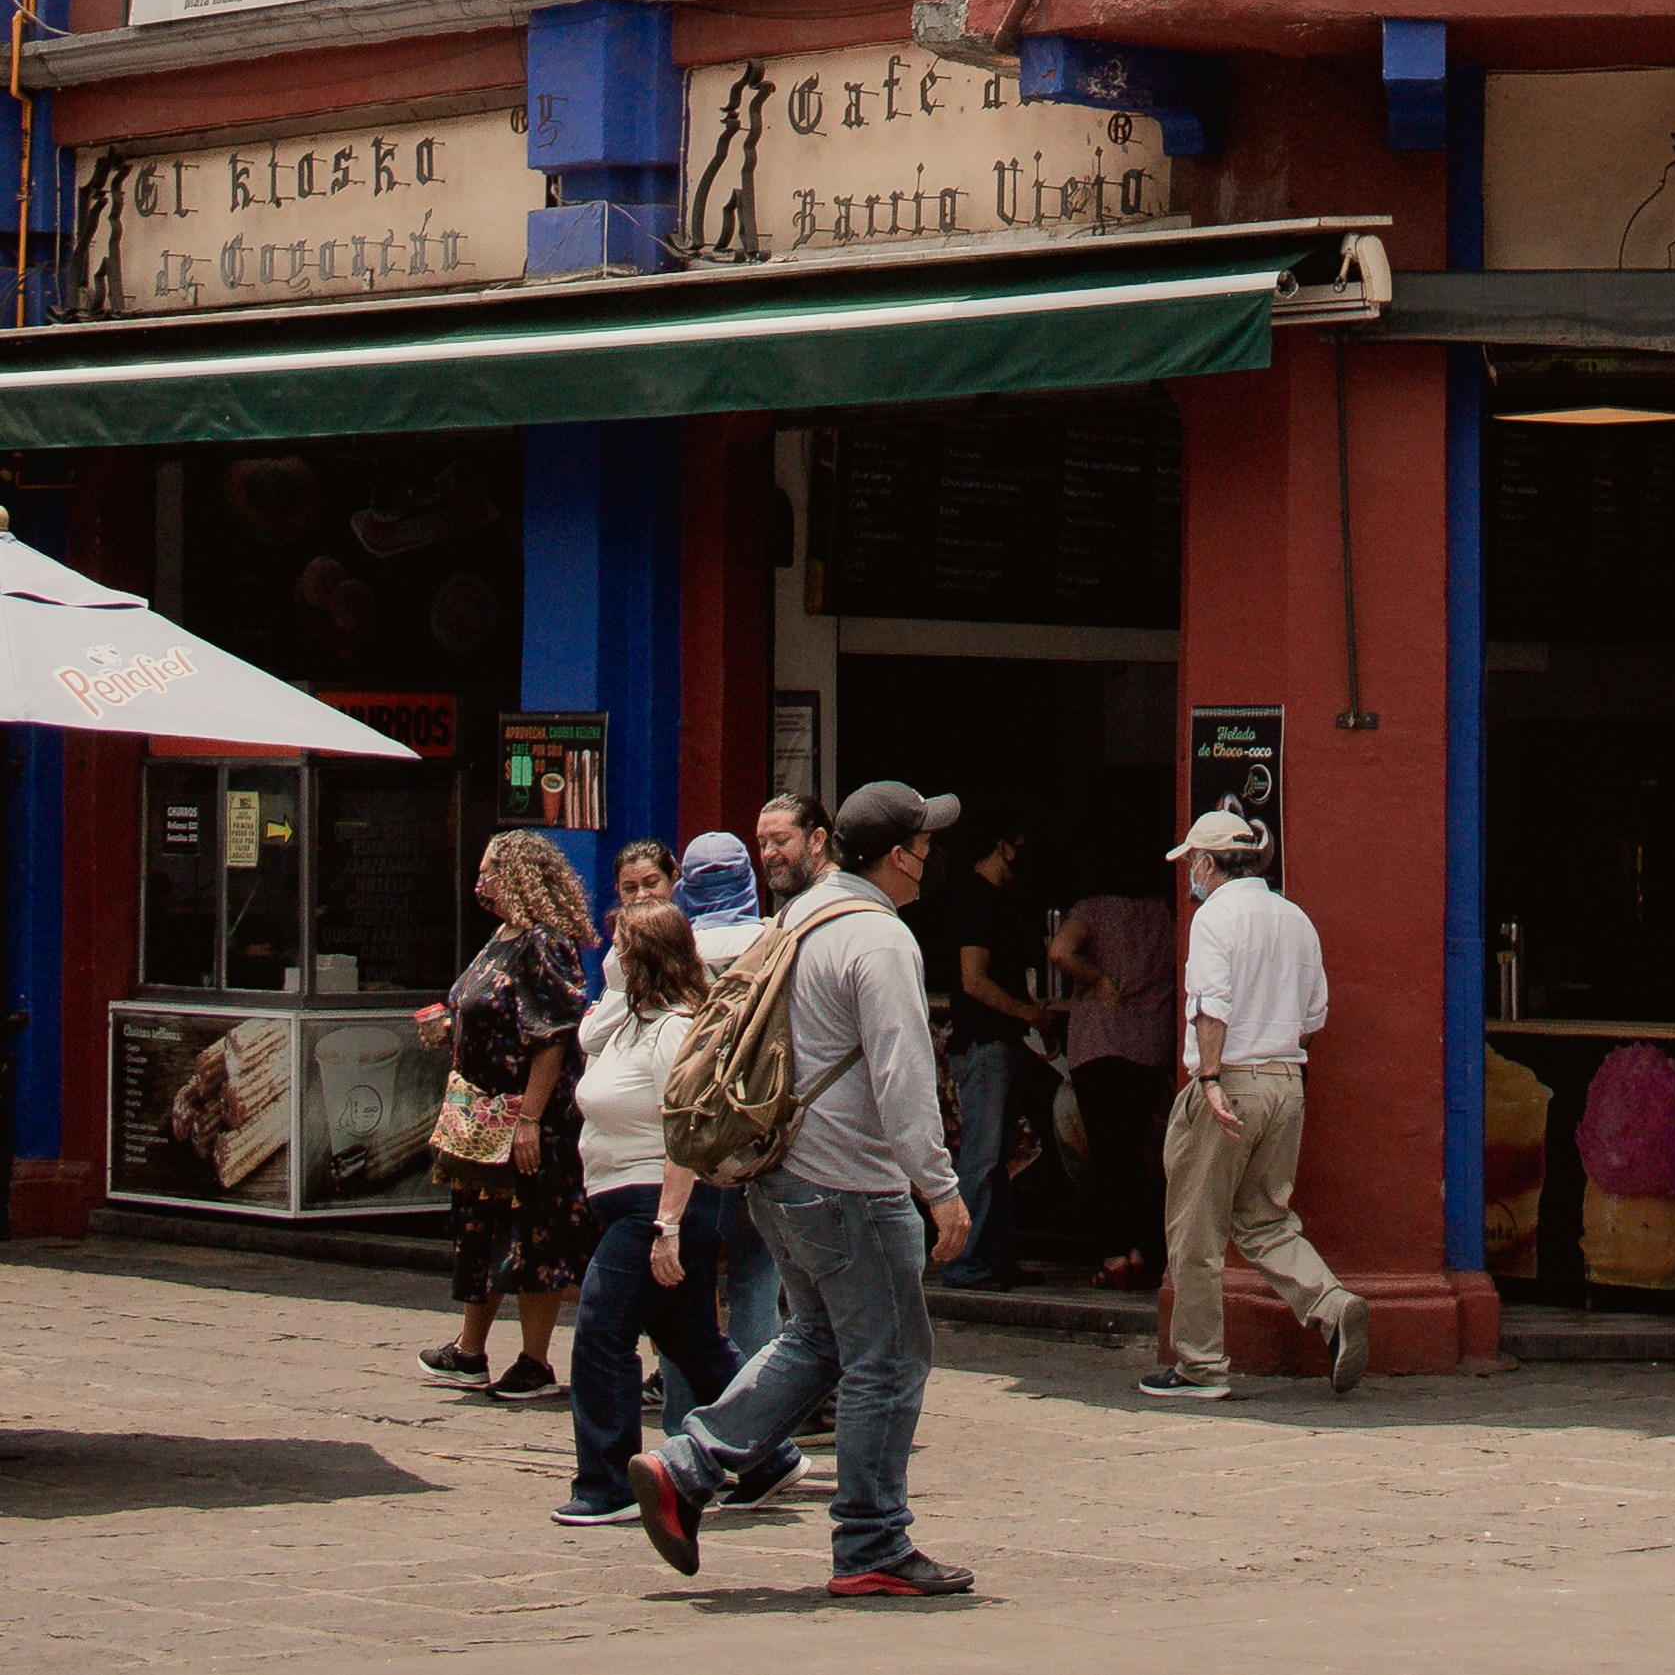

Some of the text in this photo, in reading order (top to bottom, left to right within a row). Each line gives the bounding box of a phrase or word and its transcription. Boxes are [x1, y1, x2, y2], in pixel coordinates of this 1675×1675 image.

[134, 158, 190, 218] El
[792, 146, 1148, 252] Barrio Viejo
[154, 208, 466, 298] de Coyoacán
[57, 646, 197, 718] Peñafiel
[338, 704, 451, 747] RROS
[1197, 742, 1273, 759] de Choco-coco
[1217, 725, 1257, 742] Helado
